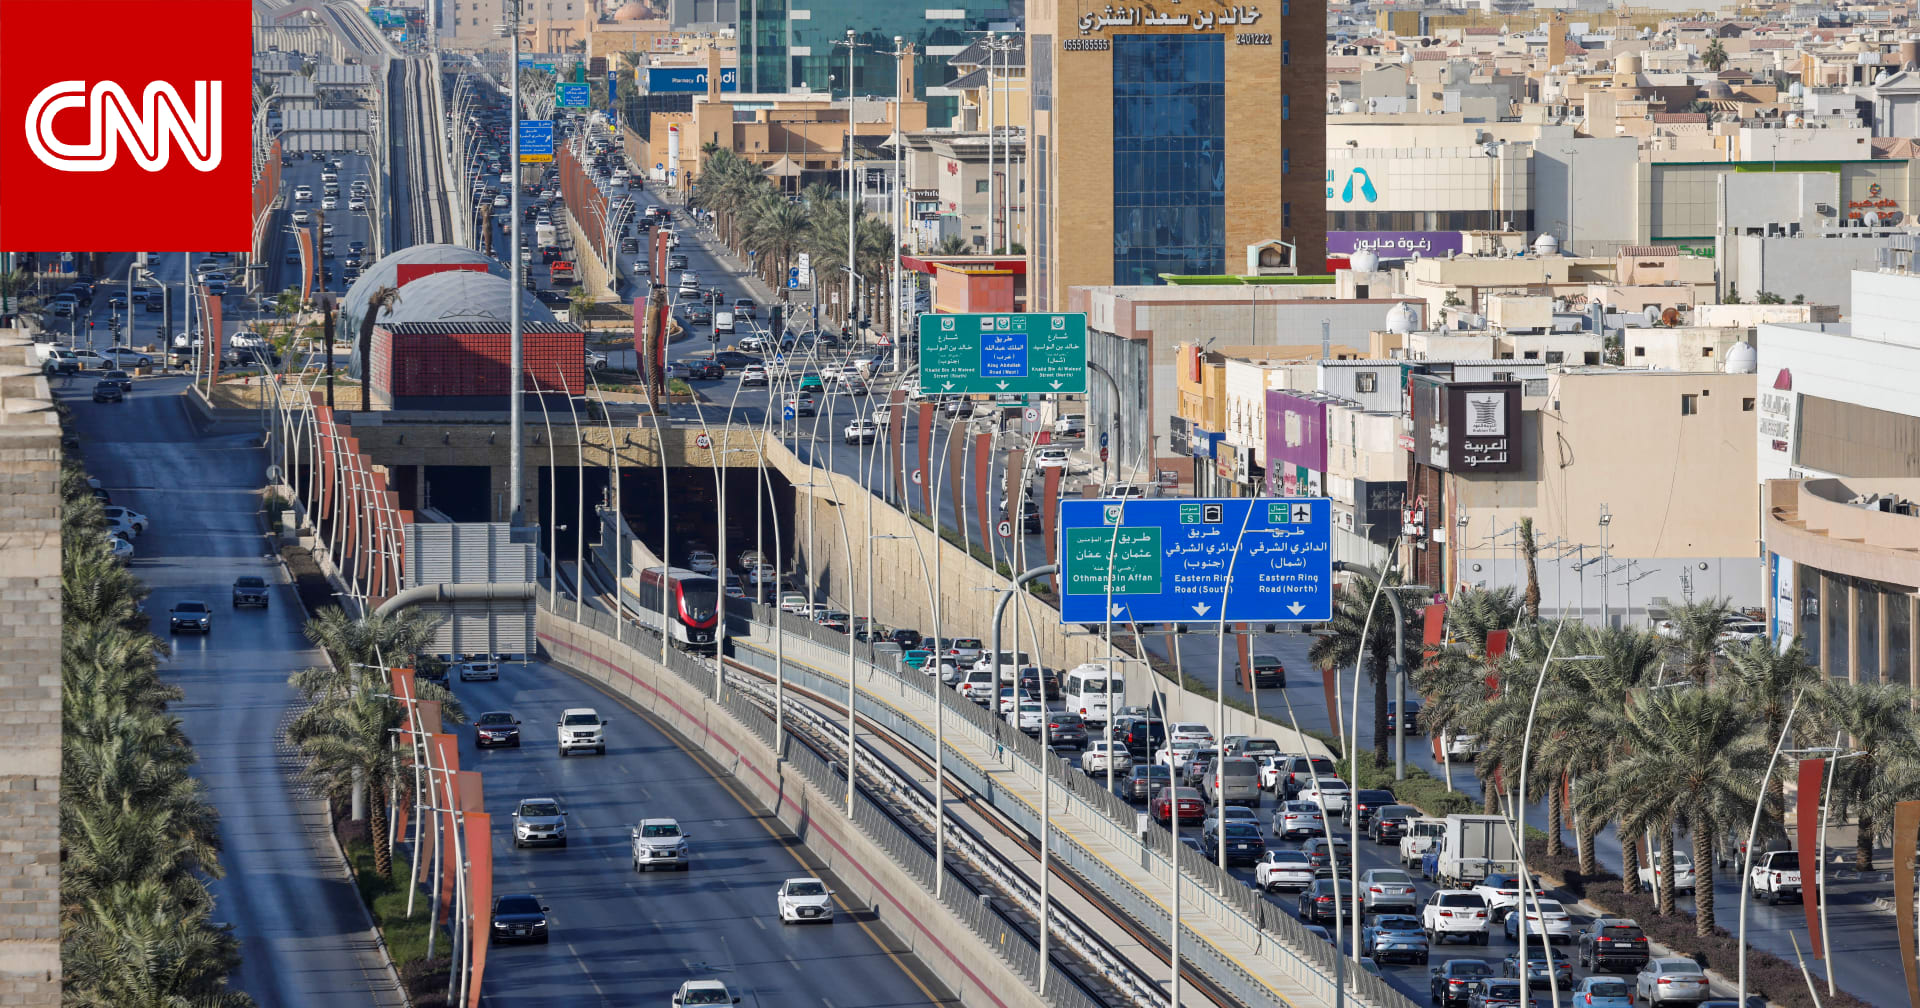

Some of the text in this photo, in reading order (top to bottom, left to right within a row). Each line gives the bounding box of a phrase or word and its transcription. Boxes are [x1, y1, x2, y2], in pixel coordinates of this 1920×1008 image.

[1078, 5, 1261, 35] خالد بن سعد الشثري
[1236, 33, 1270, 44] 2401222
[1064, 40, 1108, 50] 0555185555
[696, 72, 736, 84] ndi
[1354, 237, 1430, 252] رغوة صابون
[938, 334, 958, 342] شارع
[994, 336, 1013, 344] طريق
[1048, 332, 1068, 342] شارع
[926, 344, 948, 352] الوليد
[1464, 438, 1506, 454] العربية
[1464, 452, 1507, 466] للعود
[1187, 515, 1194, 523] S
[1118, 532, 1151, 544] طريق
[1188, 527, 1221, 539] طريق
[1272, 526, 1305, 538] طريق
[1076, 548, 1152, 560] عثمان بن عفان
[1166, 542, 1244, 558] ادائري الشرقي
[1250, 542, 1328, 556] الدائري الشرقي
[1184, 558, 1225, 570] (جنوب)
[1270, 557, 1307, 569] (شمال)
[1073, 574, 1153, 582] Othman Bin Affan
[1174, 574, 1234, 584] Eastern Ring
[1259, 574, 1318, 583] Eastern Ring
[1174, 585, 1234, 594] Road (Sout)
[1259, 585, 1318, 594] Road (North)
